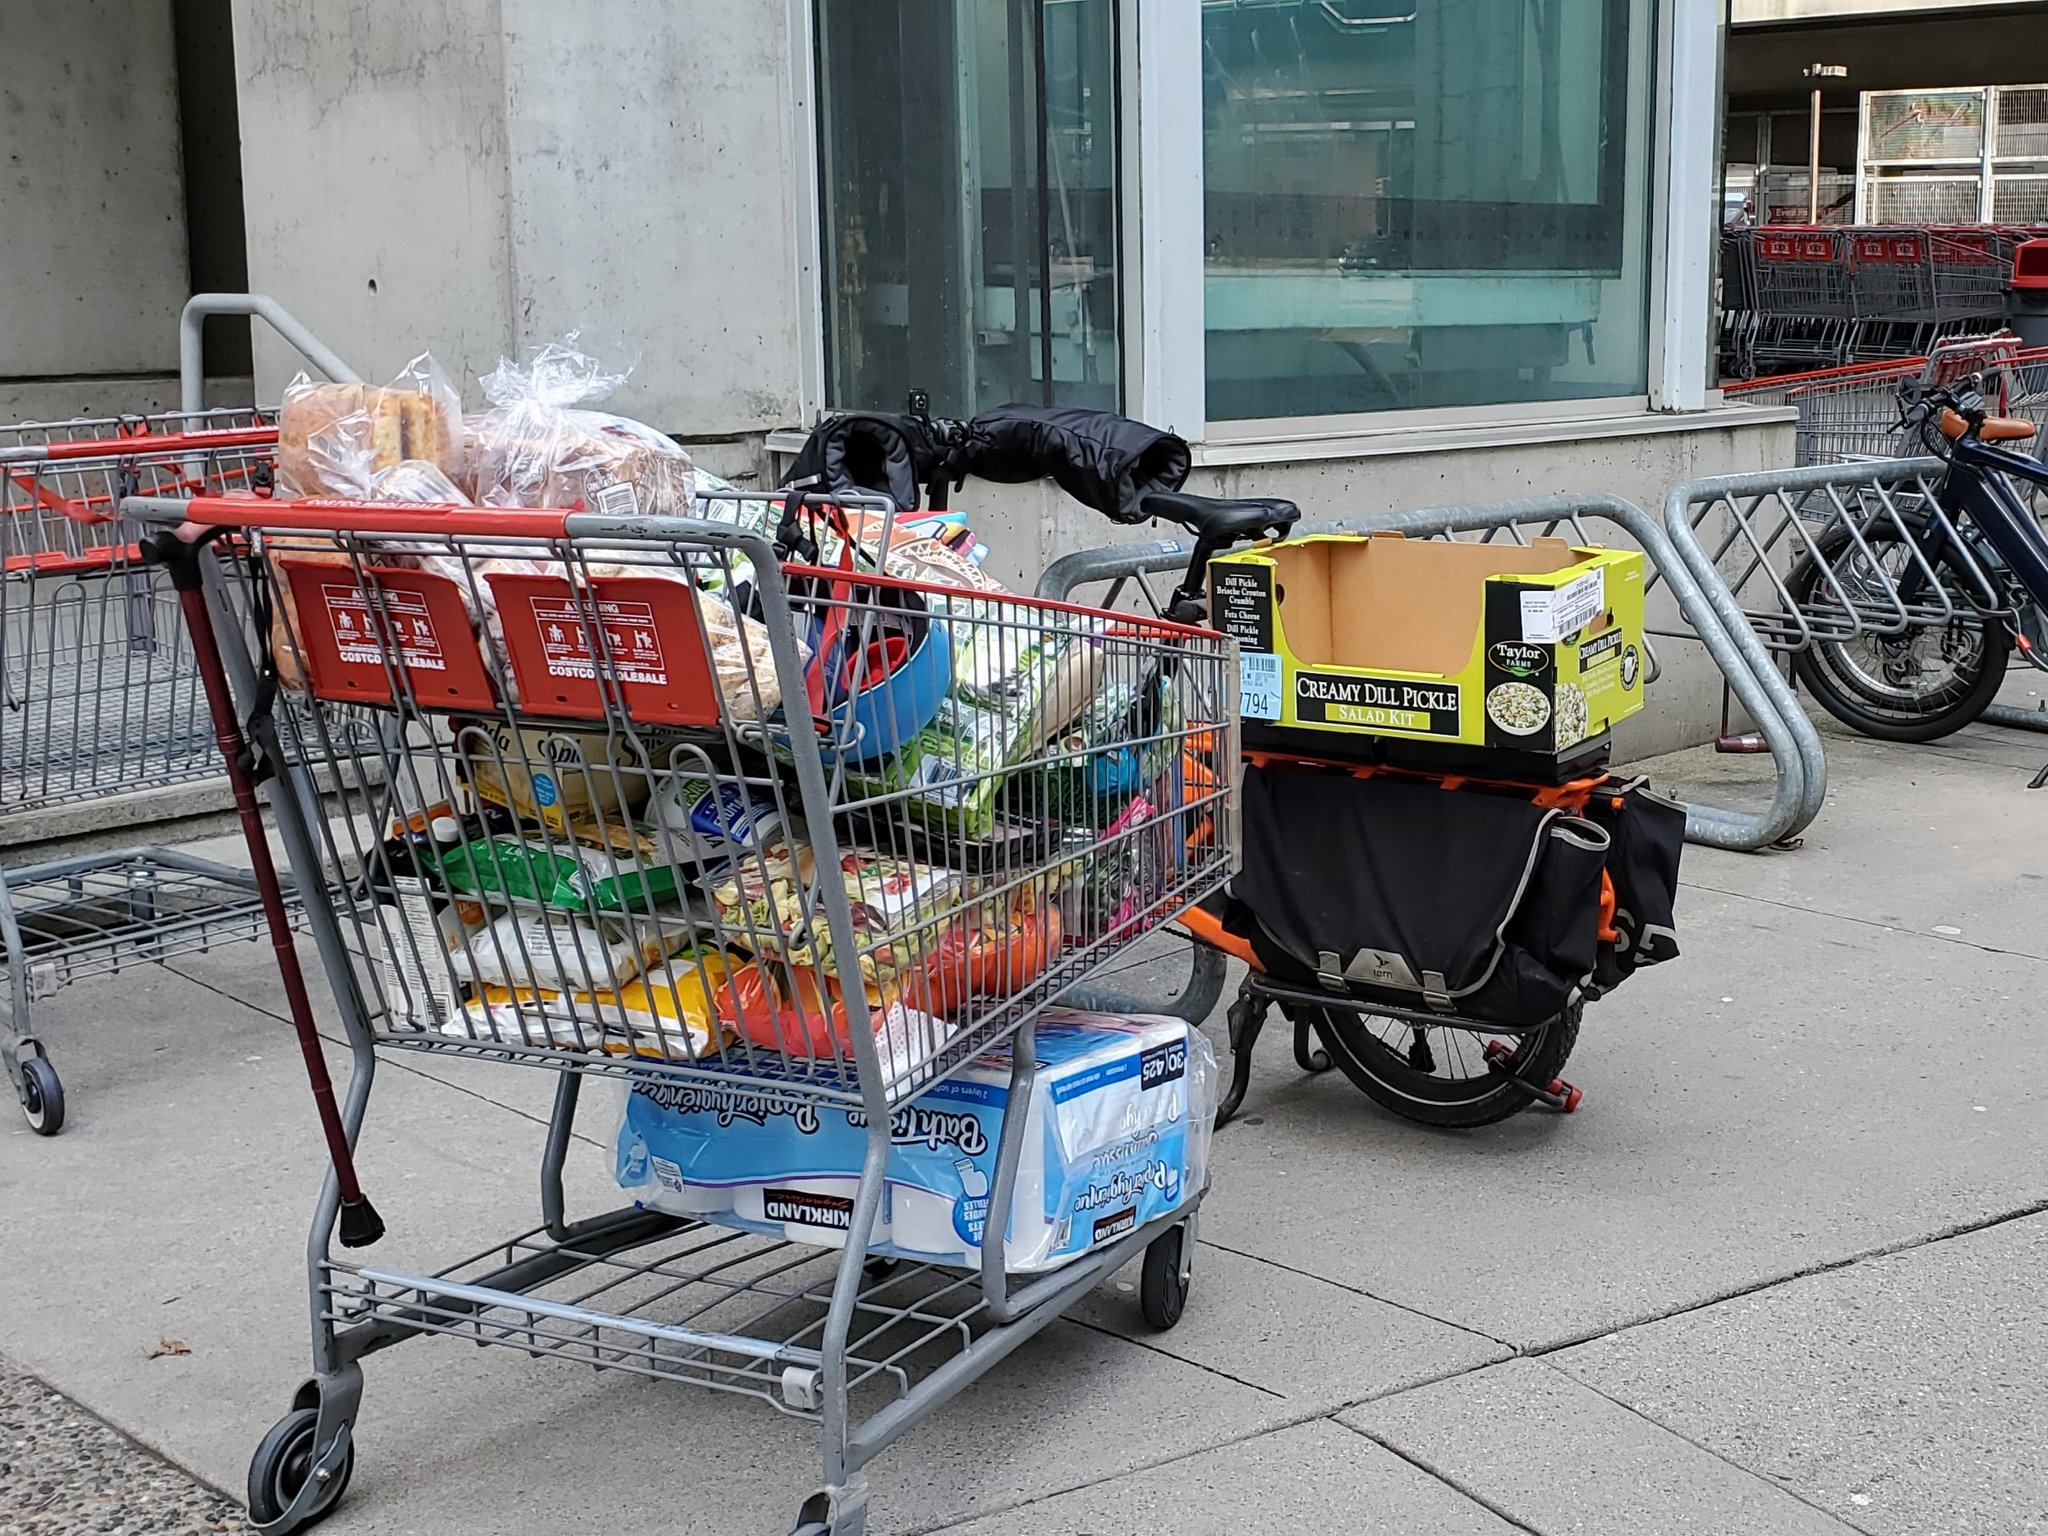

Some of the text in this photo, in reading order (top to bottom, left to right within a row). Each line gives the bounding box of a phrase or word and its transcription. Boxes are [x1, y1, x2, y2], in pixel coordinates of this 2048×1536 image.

[1225, 577, 1258, 588] Dill Pickle
[1216, 586, 1267, 597] Brioche Crouton
[1228, 596, 1255, 605] Crumble
[1224, 610, 1260, 620] Feta Cheese
[1226, 624, 1259, 635] Dill Pickle
[340, 651, 382, 665] COSTCO
[1497, 644, 1541, 660] Taylor
[1506, 658, 1531, 668] FARMS
[549, 666, 595, 680] COSTCO
[1297, 677, 1361, 702] CREAMY
[1364, 683, 1400, 706] DILL
[1402, 687, 1458, 711] PICKLE
[1339, 705, 1415, 726] SALAD KIT
[1168, 1051, 1184, 1071] 30
[1143, 1059, 1165, 1081] 425
[918, 1110, 987, 1155] Bath
[766, 1202, 850, 1227] KIRKLAND
[1095, 1215, 1134, 1240] KIRKLAND
